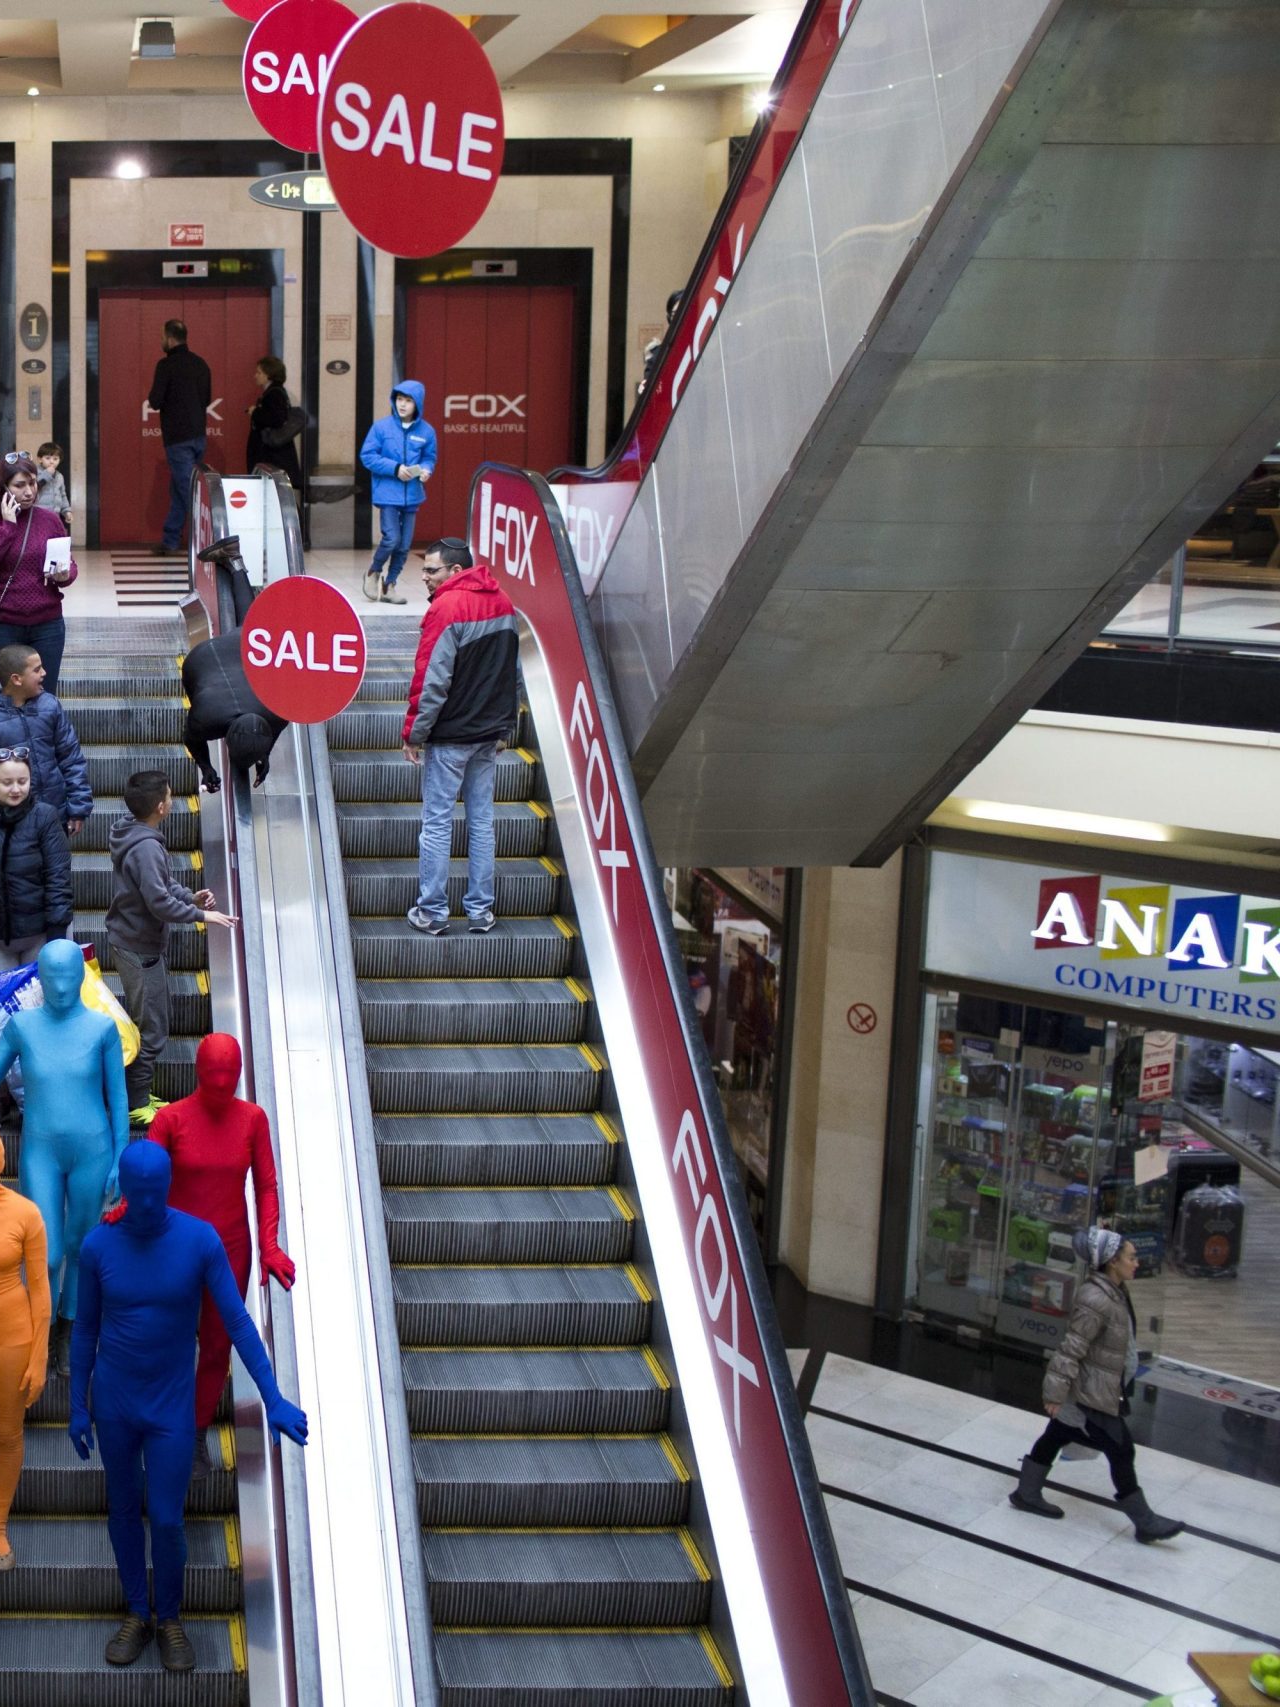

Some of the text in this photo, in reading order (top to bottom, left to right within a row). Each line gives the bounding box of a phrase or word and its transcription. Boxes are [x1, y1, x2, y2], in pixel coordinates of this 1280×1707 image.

[330, 82, 497, 181] SALE
[142, 398, 223, 421] FX
[444, 394, 527, 418] FOX
[142, 428, 163, 437] BASI
[444, 424, 526, 433] BASIC IS BEAUTIFUL
[491, 502, 538, 588] FOX
[246, 627, 359, 675] SALE
[569, 680, 630, 928] FOX
[1055, 963, 1276, 1020] COMPUTERS
[1044, 1053, 1084, 1072] yepo
[671, 1109, 760, 1449] FOX
[1019, 1317, 1058, 1337] yepo
